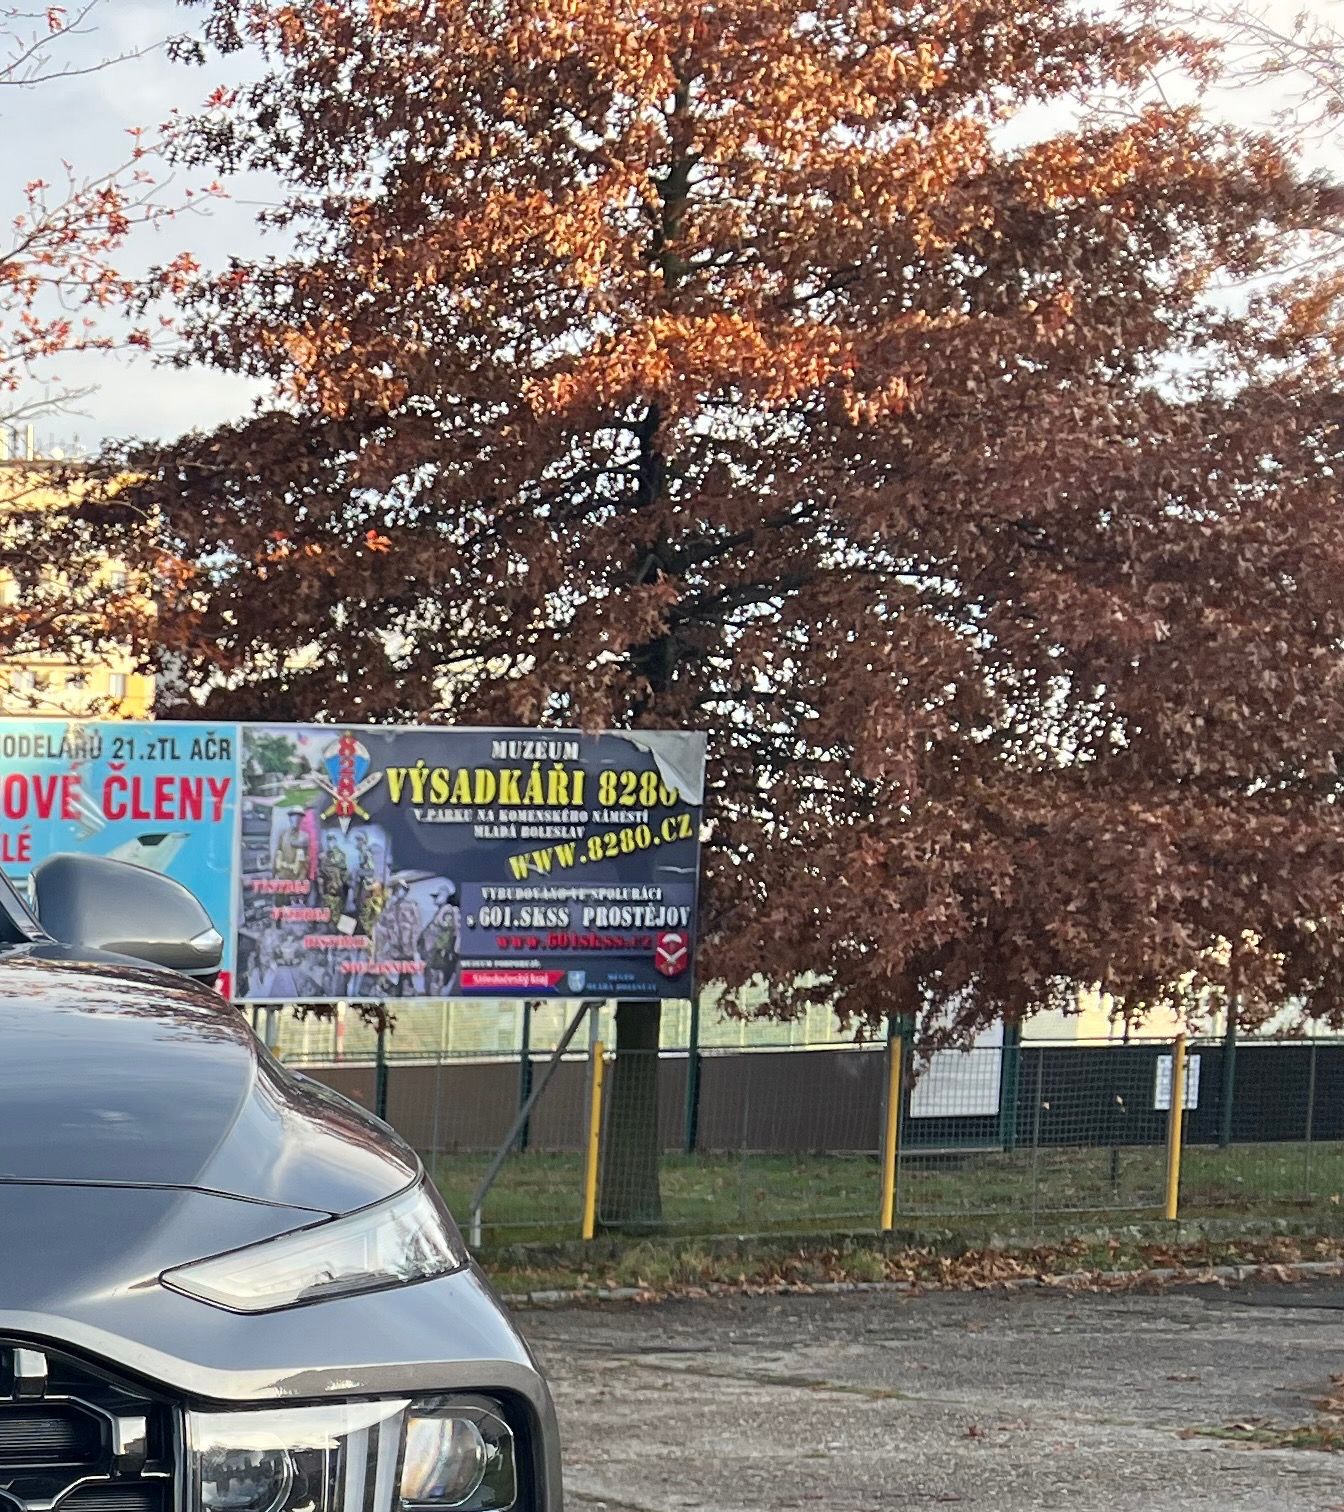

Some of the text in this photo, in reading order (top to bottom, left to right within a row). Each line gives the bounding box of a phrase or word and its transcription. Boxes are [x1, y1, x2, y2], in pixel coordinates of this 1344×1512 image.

[190, 731, 232, 760] AČR
[490, 740, 579, 760] MUZEUM
[102, 762, 233, 824] ČLENY
[386, 758, 585, 807] VÝSADKÁŘI
[582, 902, 691, 928] PROSTĚJOV
